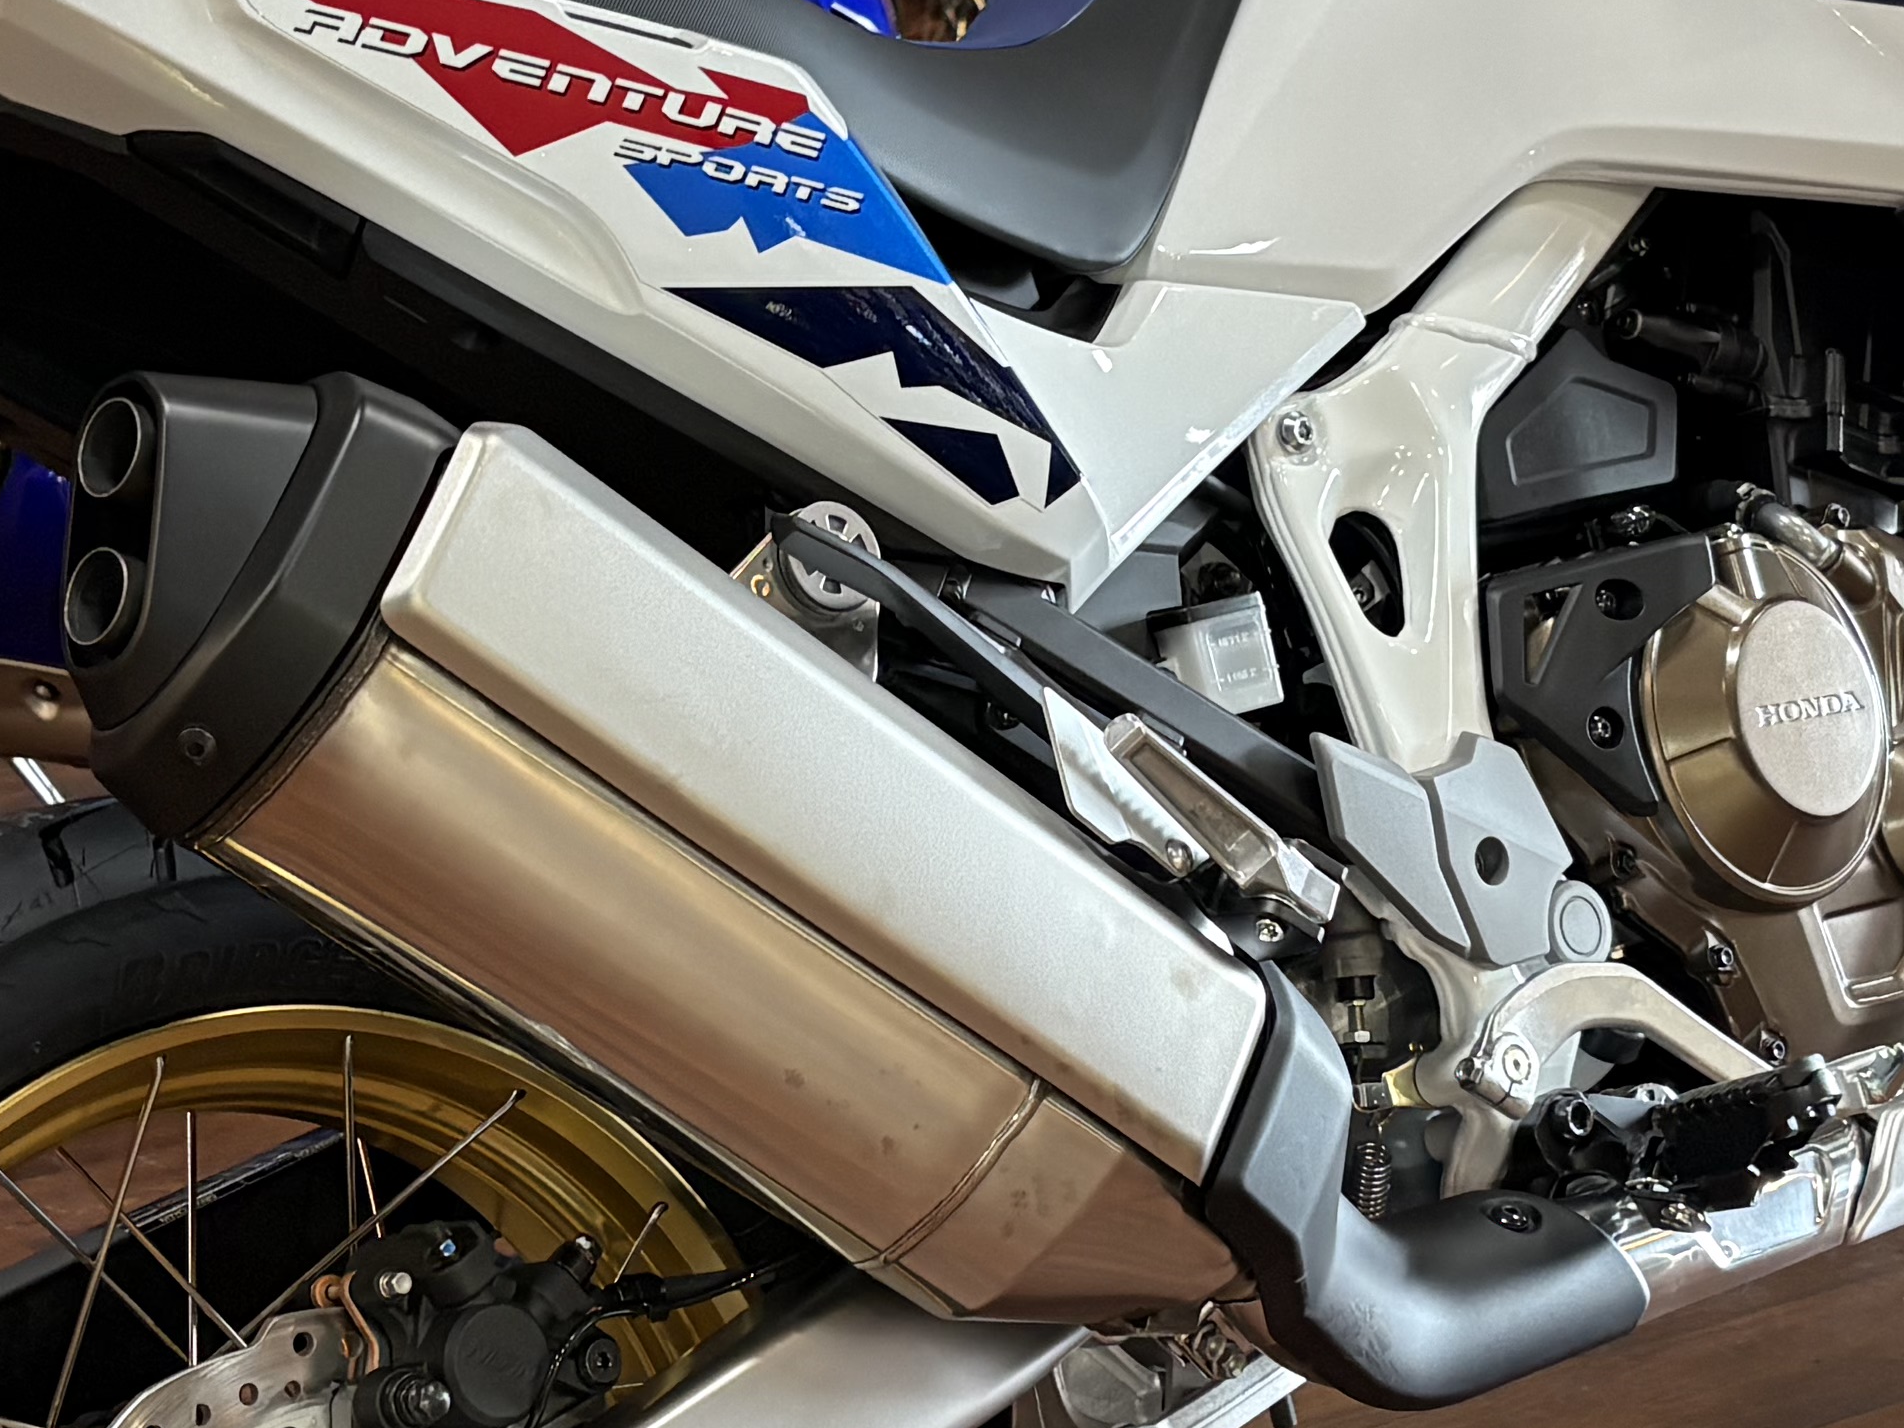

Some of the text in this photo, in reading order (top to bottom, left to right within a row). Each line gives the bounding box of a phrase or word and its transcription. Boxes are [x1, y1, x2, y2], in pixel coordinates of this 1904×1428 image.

[293, 7, 828, 160] ADVENTURE
[612, 138, 865, 217] SPORTS
[1754, 689, 1866, 729] HONDA
